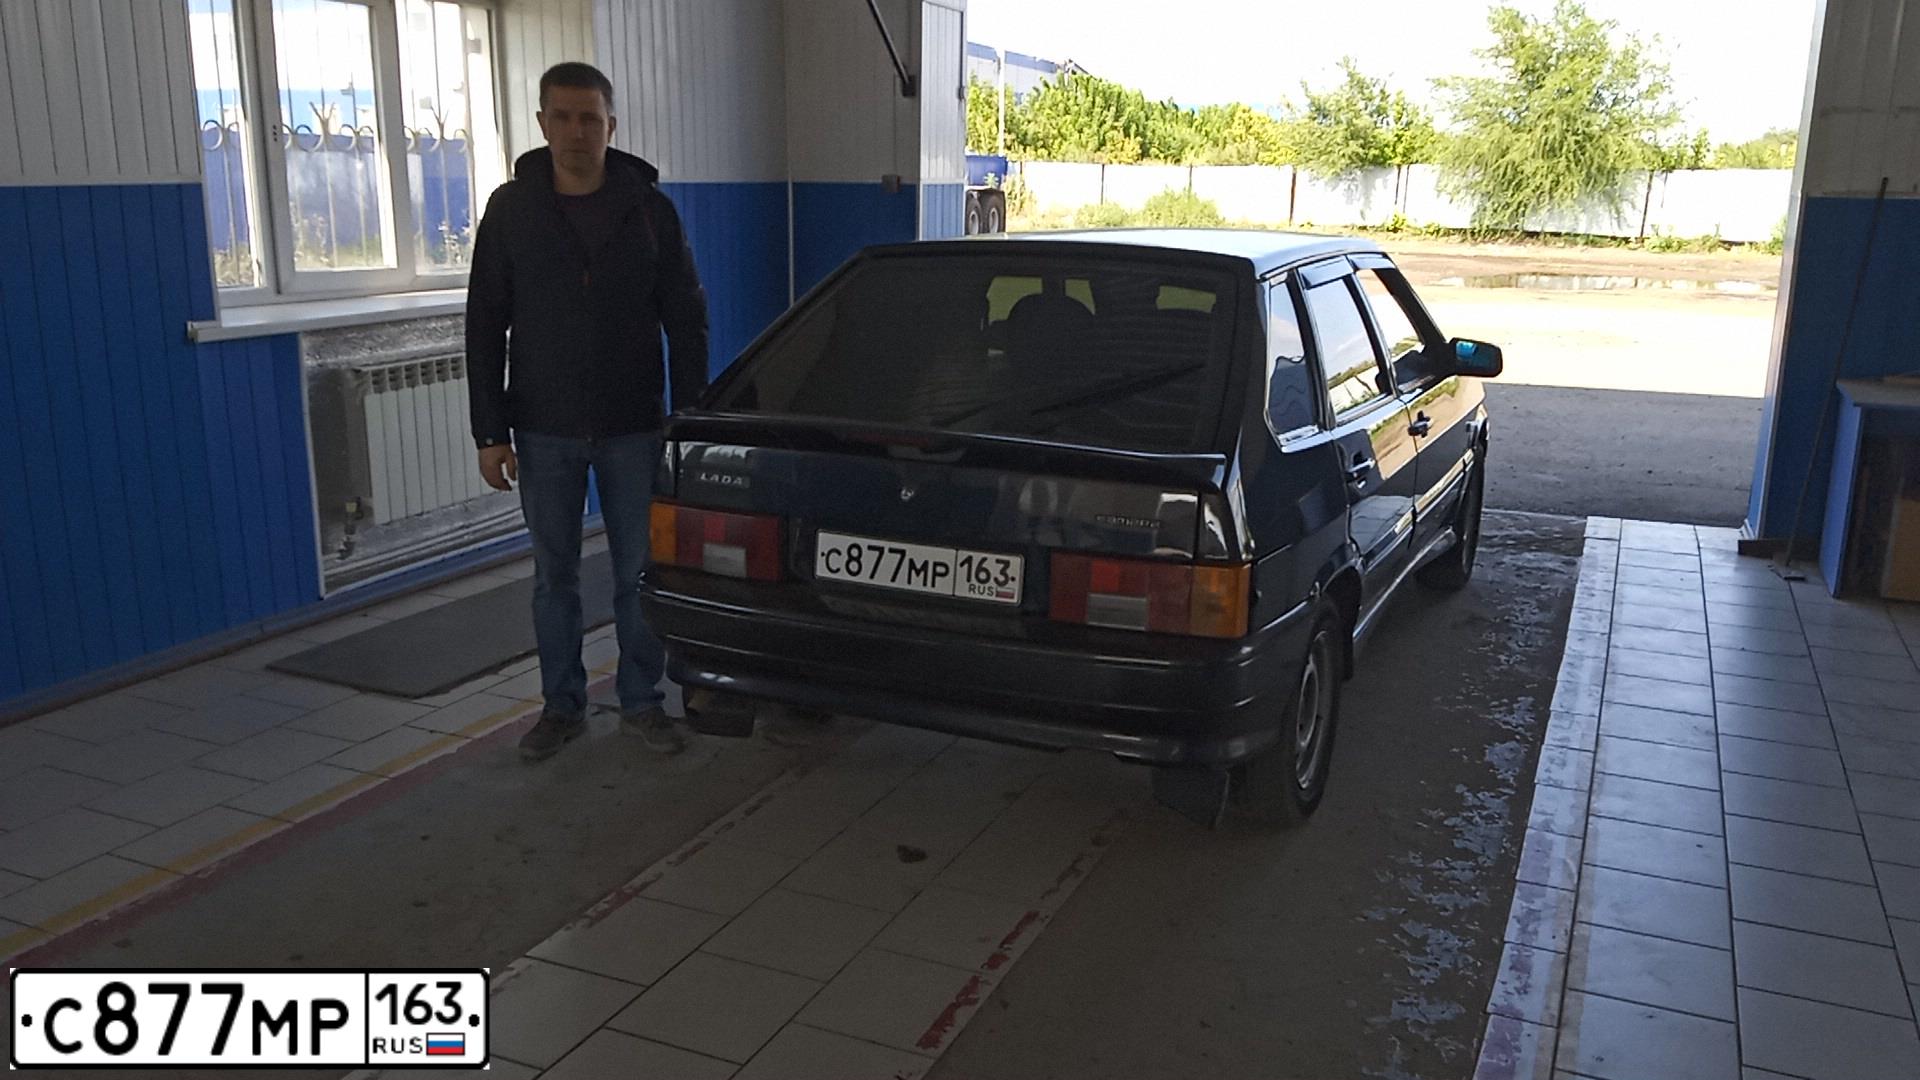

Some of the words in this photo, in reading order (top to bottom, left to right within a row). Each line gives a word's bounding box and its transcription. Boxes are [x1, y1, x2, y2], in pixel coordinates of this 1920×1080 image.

[699, 472, 743, 486] LADA
[959, 555, 1012, 587] 163
[968, 583, 995, 597] RUS
